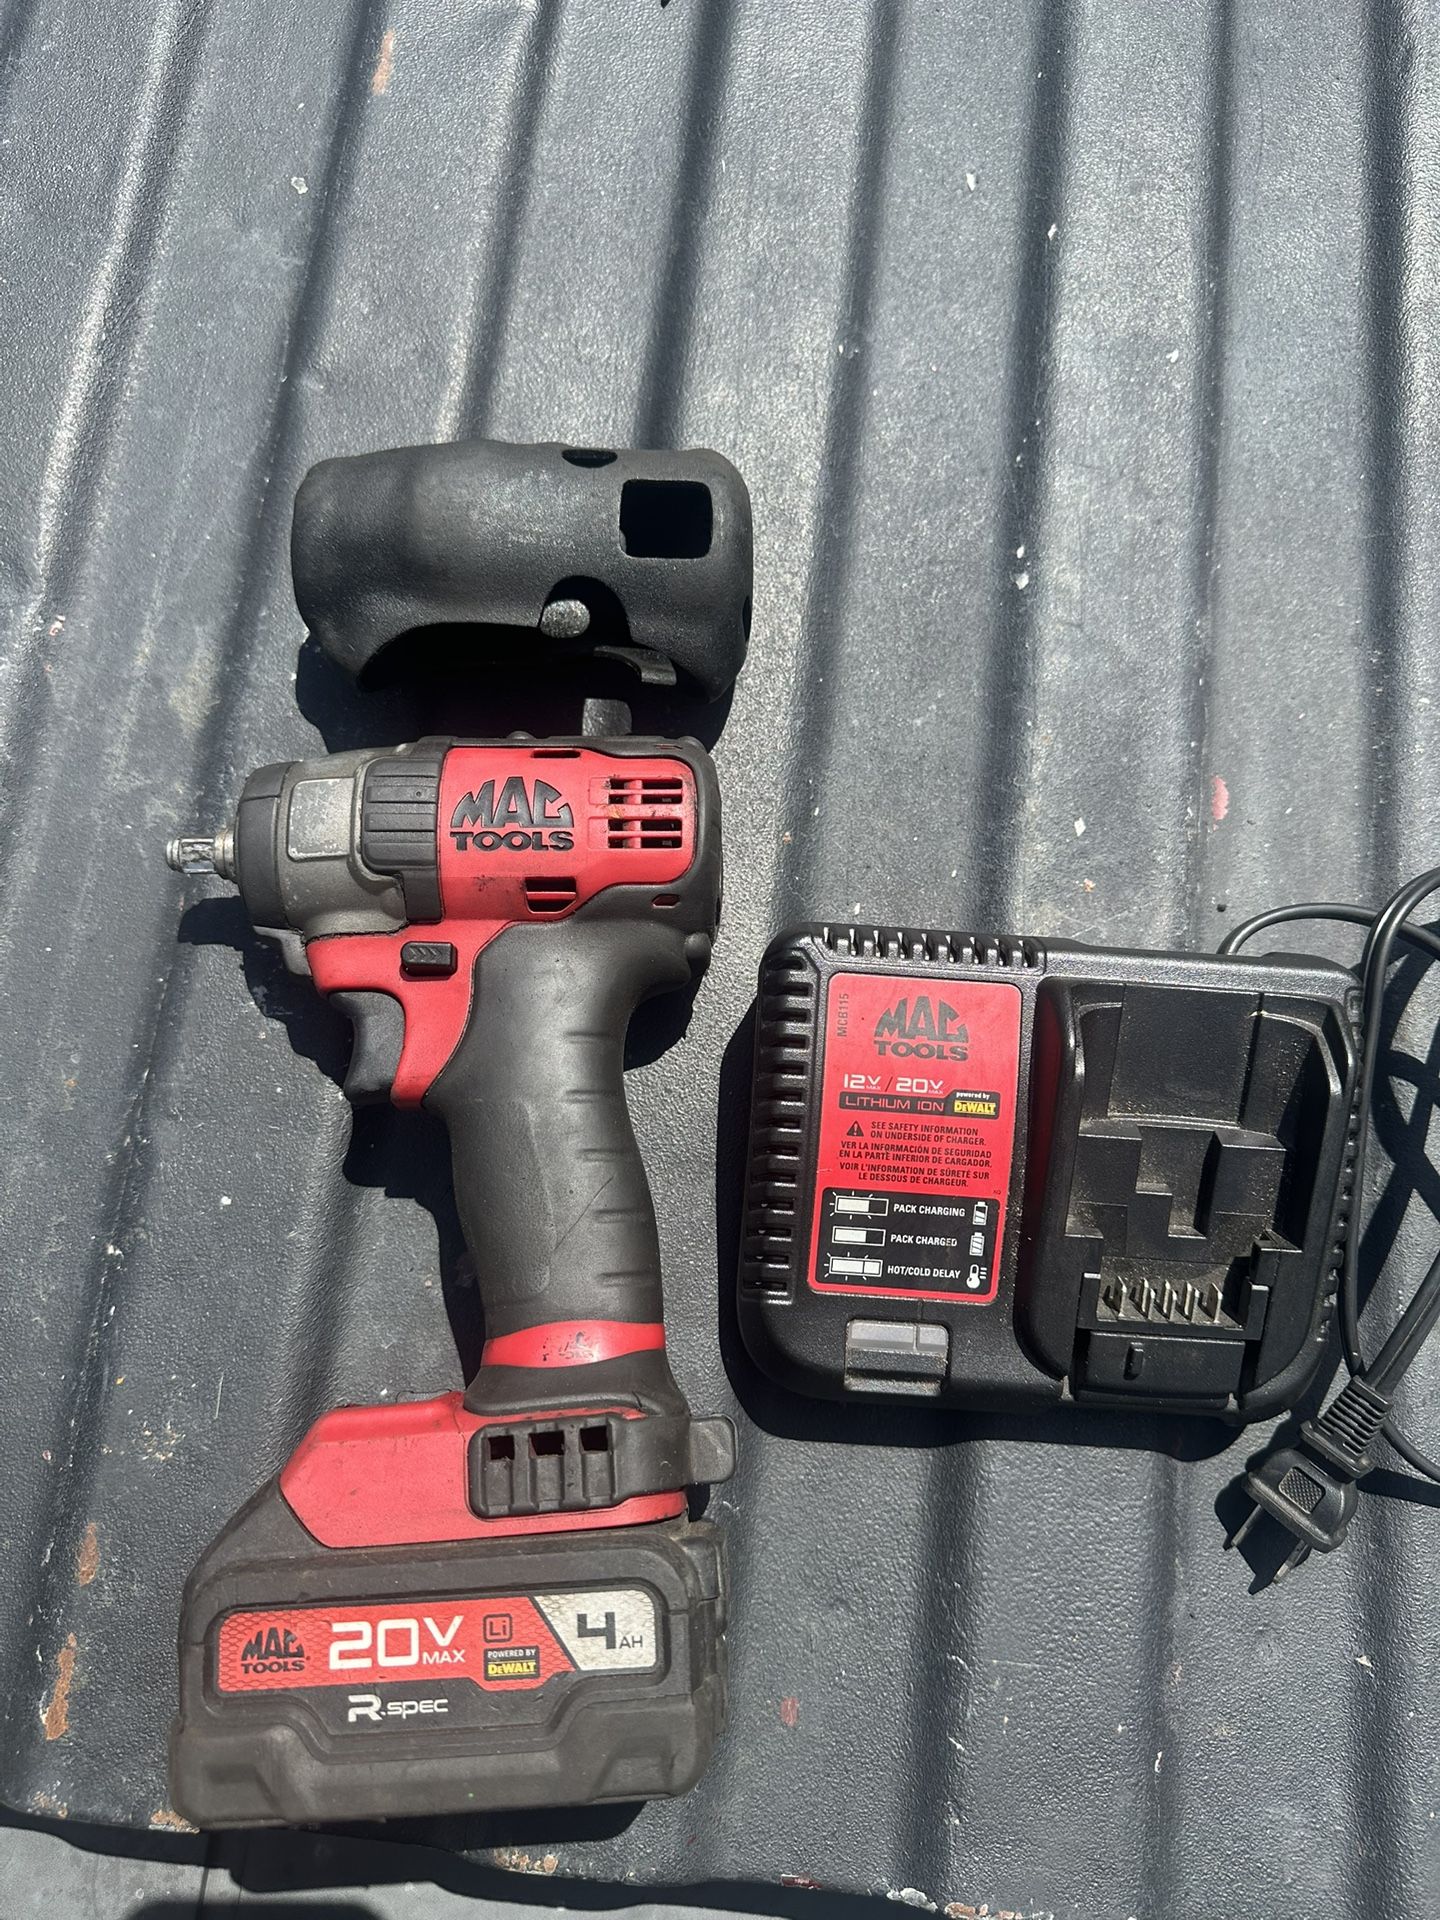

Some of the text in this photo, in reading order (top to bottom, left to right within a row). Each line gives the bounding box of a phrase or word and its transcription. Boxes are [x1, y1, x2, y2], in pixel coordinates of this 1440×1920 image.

[450, 776, 574, 828] MAC
[450, 831, 574, 851] TOOLS
[837, 993, 849, 1037] MCB115
[874, 995, 969, 1043] MAC
[874, 1040, 969, 1061] TOOLS
[896, 1077, 944, 1093] 20V
[845, 1095, 945, 1112] LITHIUM ION
[956, 1091, 982, 1100] powered
[871, 1121, 979, 1136] SEE SAFETY INFORMATION
[870, 1130, 987, 1146] ON UNDERSIDE OF CHARGER.
[841, 1140, 992, 1158] VER LA INFORMACIÓN DE SEGURIDAD
[839, 1150, 992, 1168] EN LA PARTE INFERIOR DE CARGADOR.
[840, 1162, 859, 1170] VOIR
[861, 1163, 925, 1176] L'INFORMATION
[927, 1167, 938, 1175] DE
[973, 1171, 990, 1180] SUR
[858, 1172, 969, 1187] LE DESSOUS DE CHARGEUR.
[893, 1203, 966, 1217] PACK CHARGING
[890, 1234, 958, 1247] PACK CHARGED
[887, 1265, 961, 1279] HOT/COLD DELAY
[489, 1621, 506, 1636] Li
[577, 1612, 643, 1650] 4 AH
[241, 1626, 305, 1661] MAC
[329, 1615, 466, 1670] 20V MAX
[487, 1648, 537, 1658] POWERED BY
[241, 1660, 305, 1674] TOOLS
